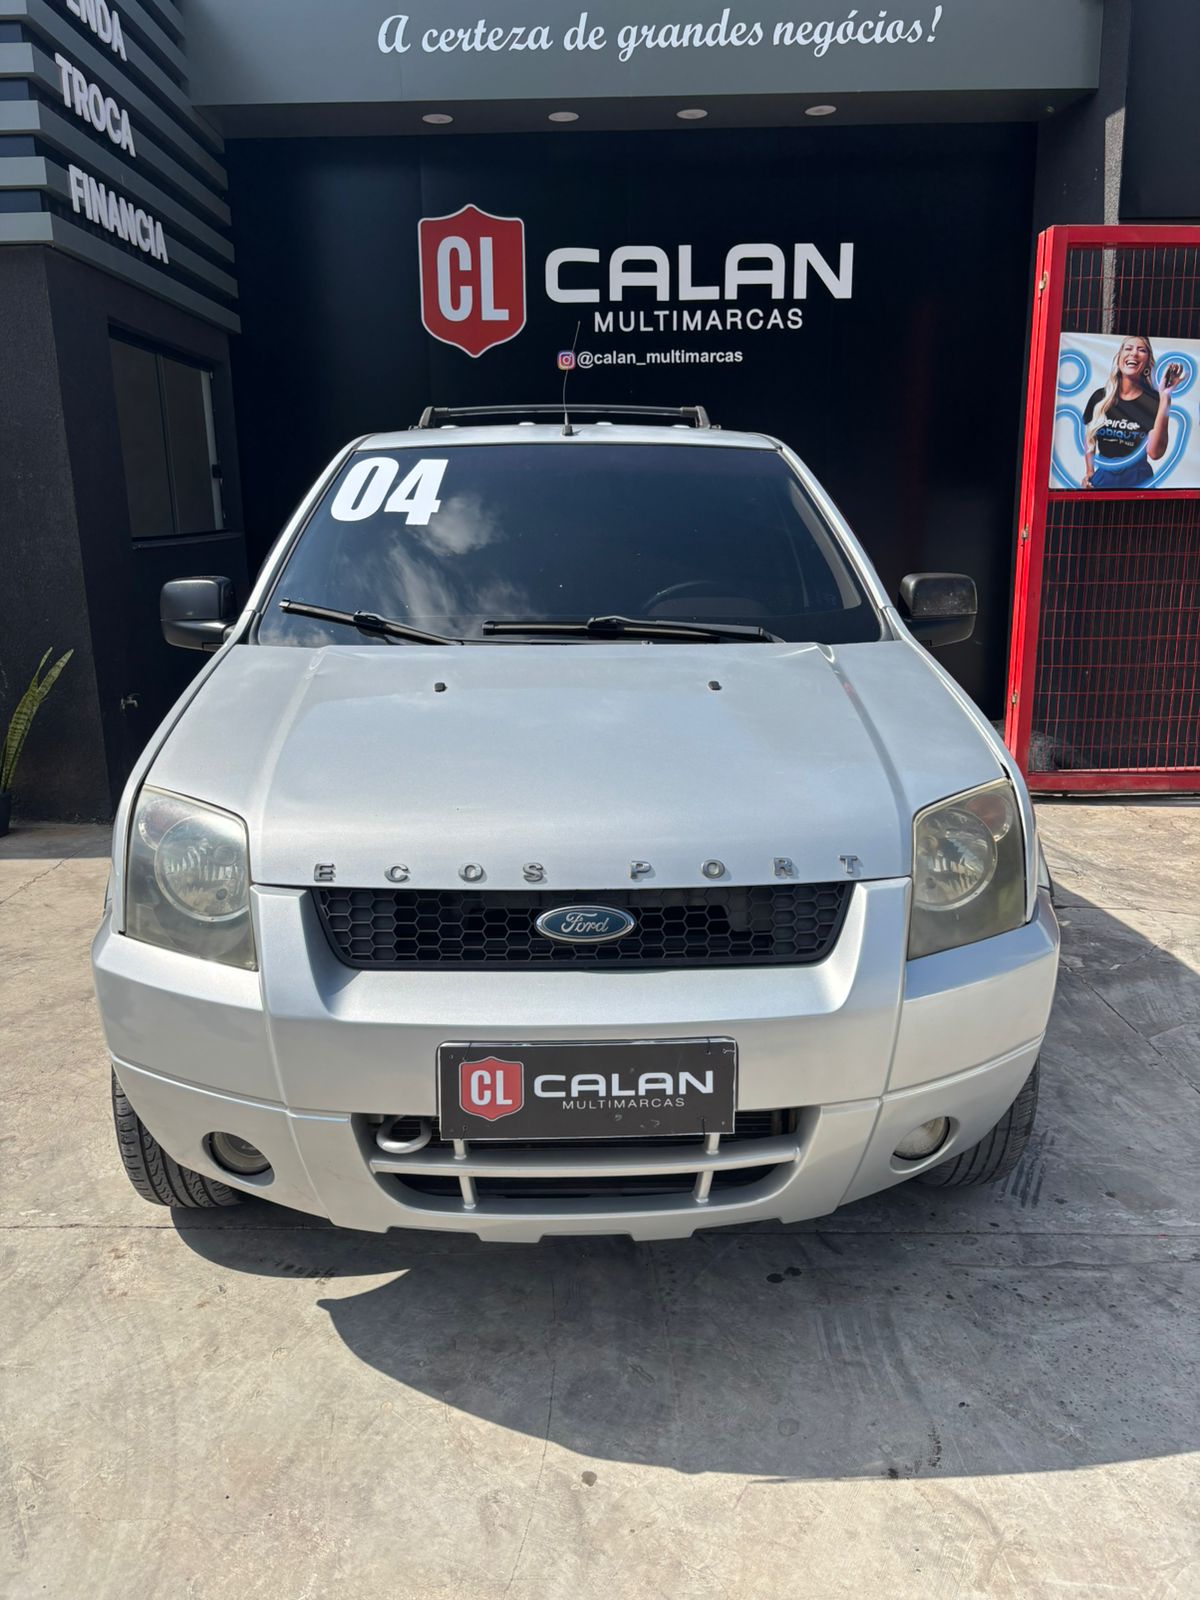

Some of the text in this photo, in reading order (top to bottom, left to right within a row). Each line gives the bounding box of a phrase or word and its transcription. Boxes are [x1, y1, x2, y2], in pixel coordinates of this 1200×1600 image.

[377, 5, 943, 62] A certeza de grandes negócios!
[55, 52, 136, 158] TROCA
[68, 164, 169, 264] FINANCIA
[437, 236, 509, 322] CL
[545, 242, 854, 303] CALAN
[594, 308, 803, 333] MULTIMARCAS
[577, 349, 743, 369] @calan_multimarcas
[330, 456, 449, 526] 04
[560, 911, 610, 933] Ford
[470, 1069, 513, 1106] CL
[533, 1070, 714, 1098] CALAN
[562, 1096, 686, 1110] MULTIMARCAS
